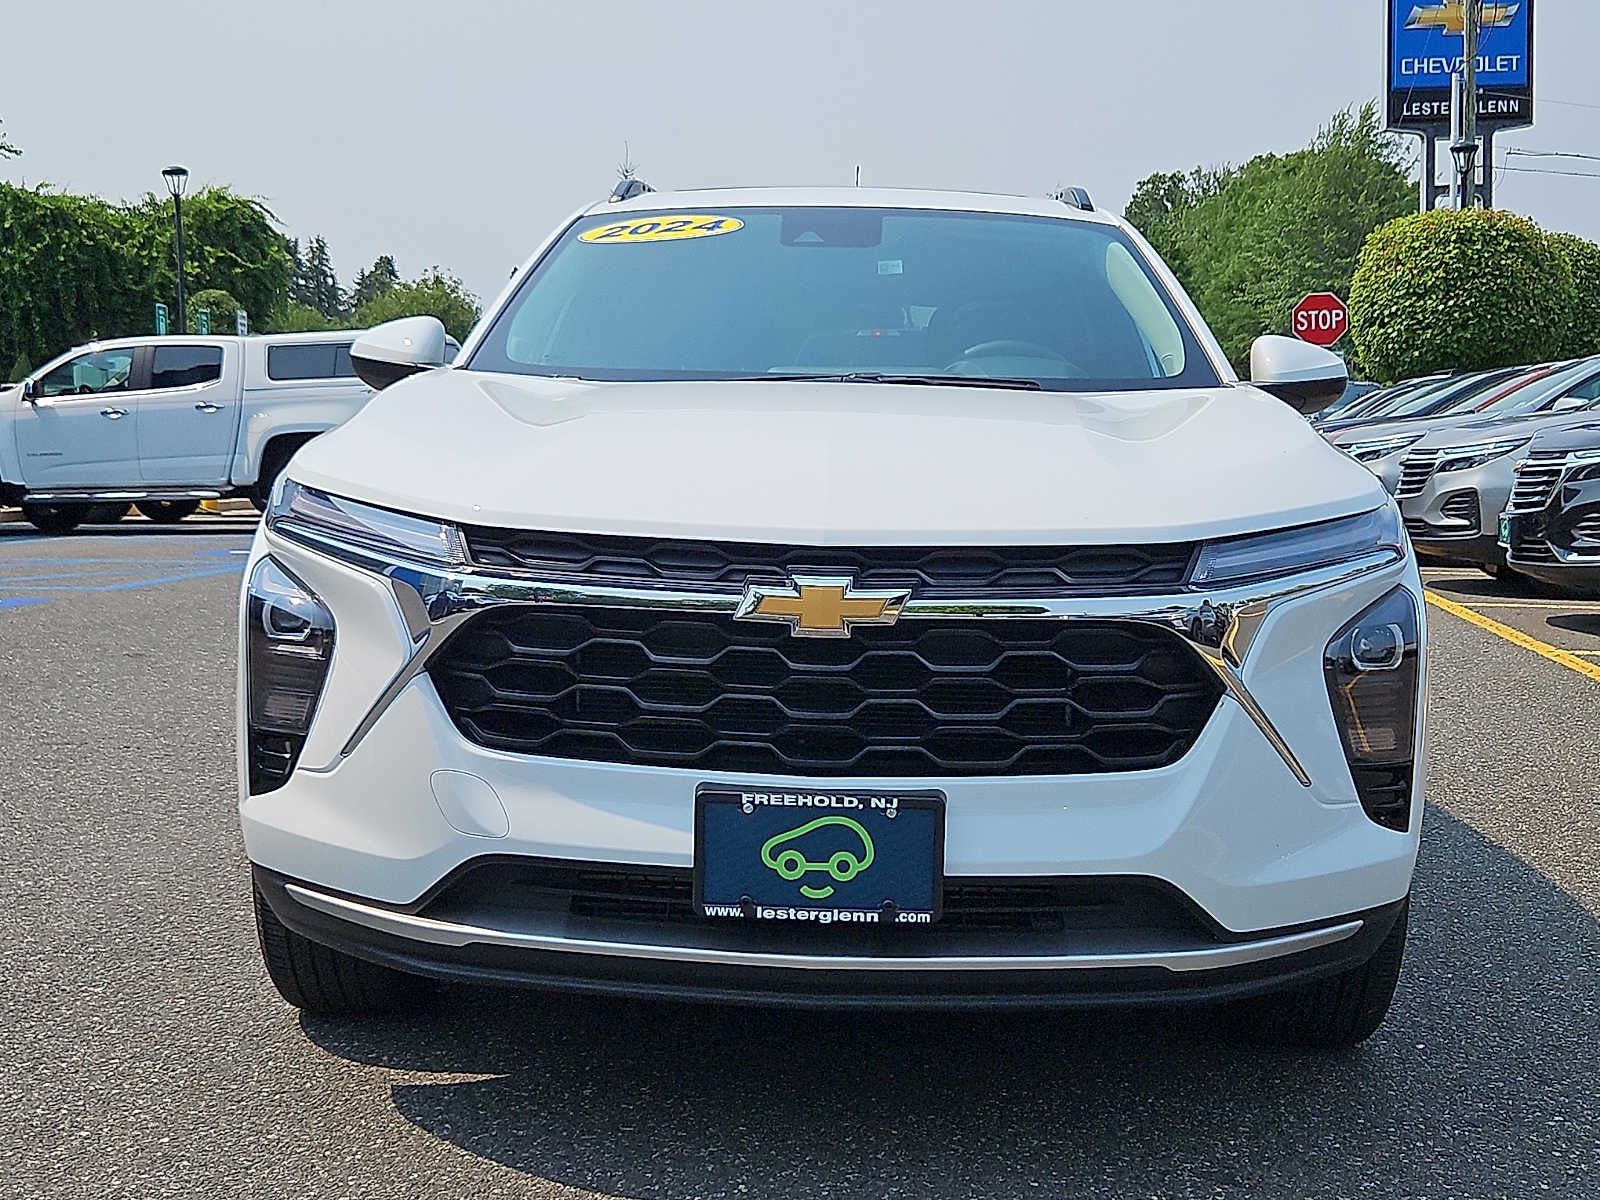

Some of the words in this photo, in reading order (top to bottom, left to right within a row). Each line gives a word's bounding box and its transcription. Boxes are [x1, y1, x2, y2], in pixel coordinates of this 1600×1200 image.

[1402, 102, 1460, 116] LESTE
[1466, 99, 1519, 114] LENN
[594, 219, 728, 240] 2024
[1296, 309, 1344, 331] STOP
[741, 793, 864, 810] FREEHOLD,
[870, 797, 899, 809] NJ
[704, 906, 744, 918] www.
[756, 906, 879, 924] lesterglenn
[894, 911, 931, 923] .com
